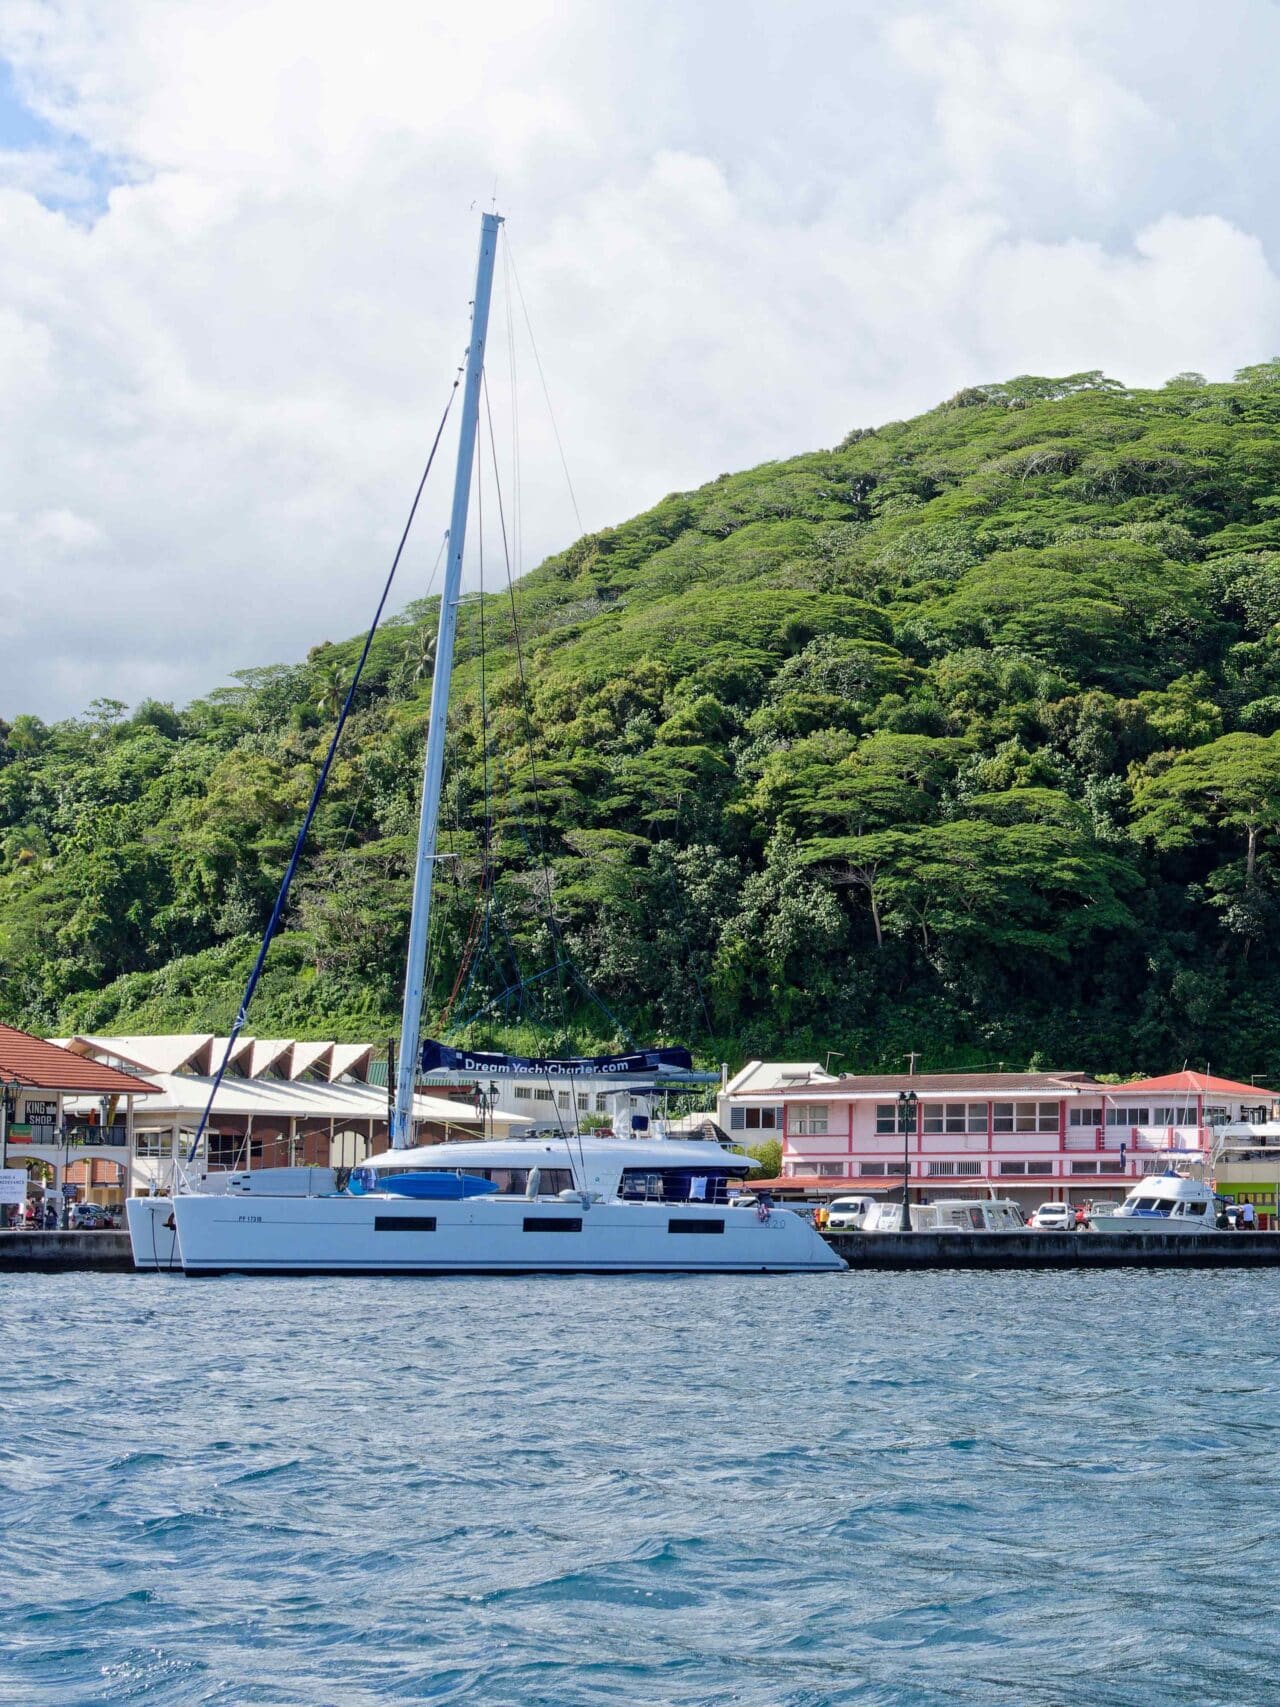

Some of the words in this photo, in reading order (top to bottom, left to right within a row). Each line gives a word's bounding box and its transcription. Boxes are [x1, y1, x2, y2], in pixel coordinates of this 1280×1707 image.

[465, 1058, 510, 1073] Dream
[26, 1101, 45, 1114] KING
[29, 1115, 52, 1125] SHOP
